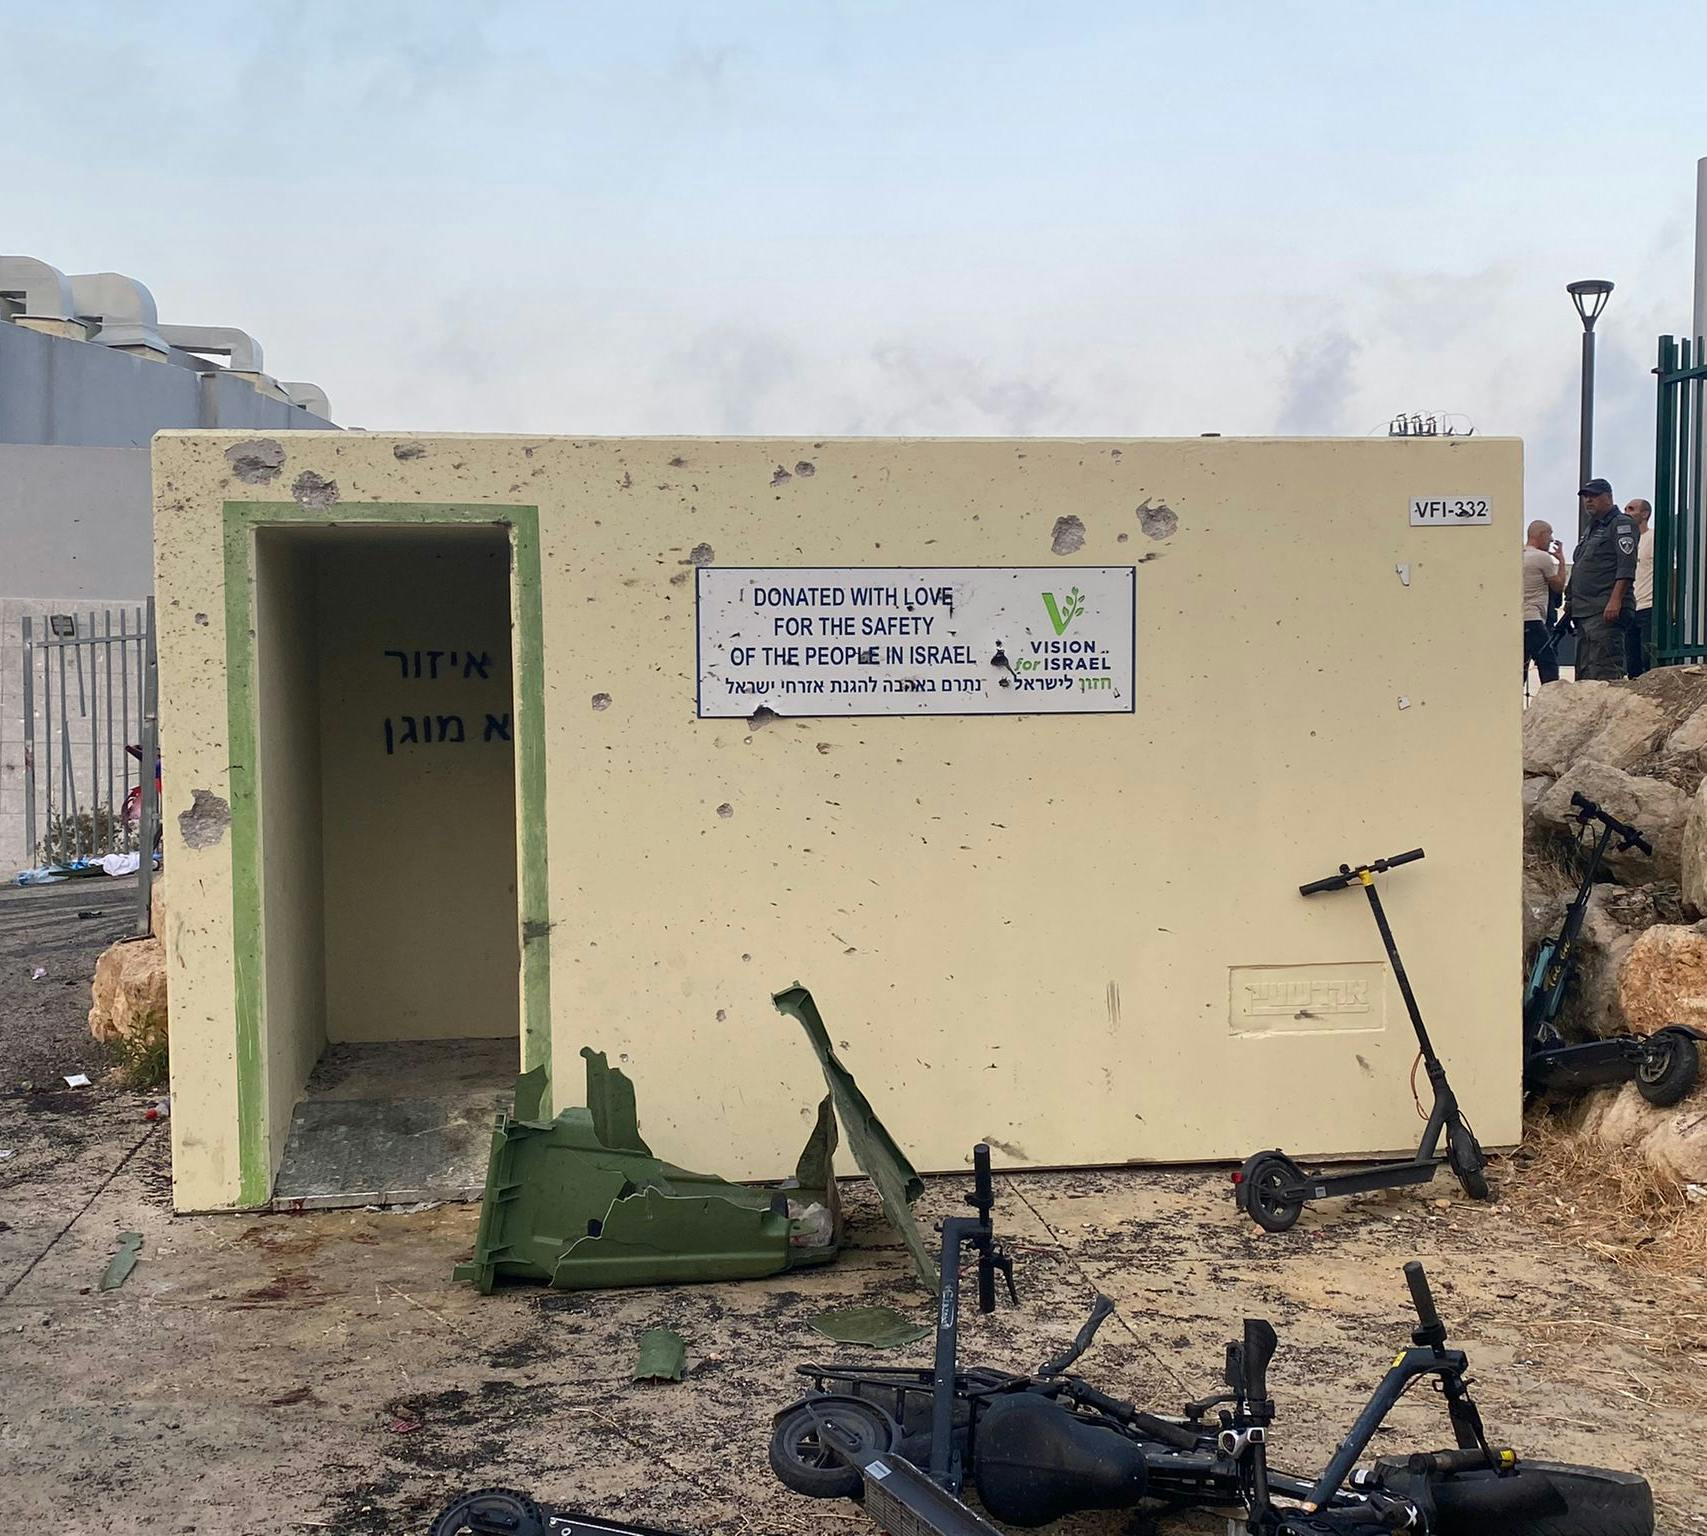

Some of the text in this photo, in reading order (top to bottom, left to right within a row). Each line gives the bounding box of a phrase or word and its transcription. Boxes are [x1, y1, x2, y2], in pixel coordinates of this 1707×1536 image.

[1416, 501, 1487, 518] VFI-332
[754, 587, 953, 607] DONATED WITH LOVE
[774, 616, 935, 636] FOR THE SAFETY
[730, 645, 977, 666] OF THE PEOPLE IN ISRAEL
[1030, 640, 1096, 654] VISION
[384, 650, 490, 679] איזור
[1014, 657, 1111, 671] for ISRAEL
[725, 676, 981, 694] נתרם באהבה להגנת אזרחי ישראל
[1014, 674, 1112, 694] חזון לישראל
[384, 714, 465, 755] מוגן
